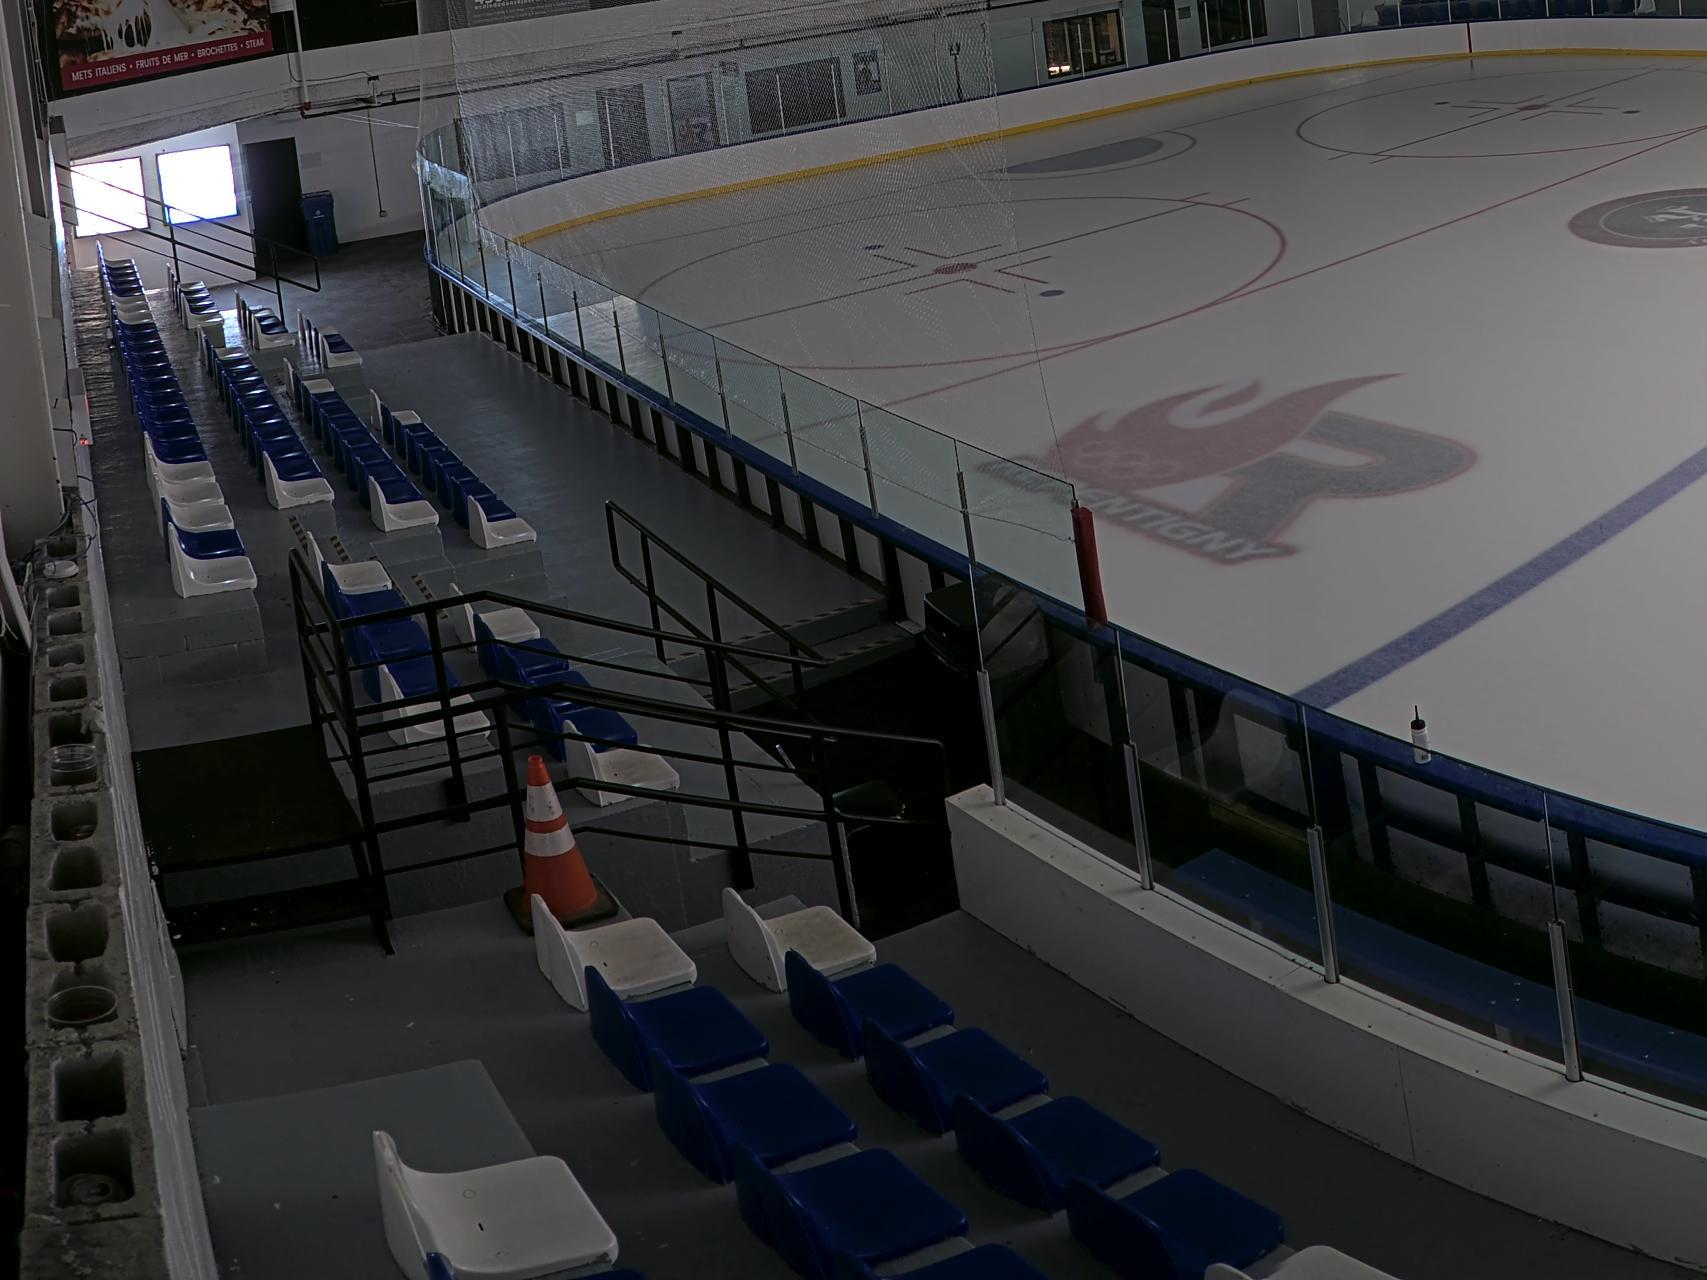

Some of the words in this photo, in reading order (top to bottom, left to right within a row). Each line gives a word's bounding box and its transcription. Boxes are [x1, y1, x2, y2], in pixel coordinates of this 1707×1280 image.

[71, 70, 93, 81] METS
[95, 63, 127, 77] ITALIENS
[135, 55, 160, 69] FRUITS
[162, 54, 172, 65] DE
[174, 51, 189, 62] MER
[197, 42, 239, 58] BROCHETTES
[246, 37, 265, 49] STEAK
